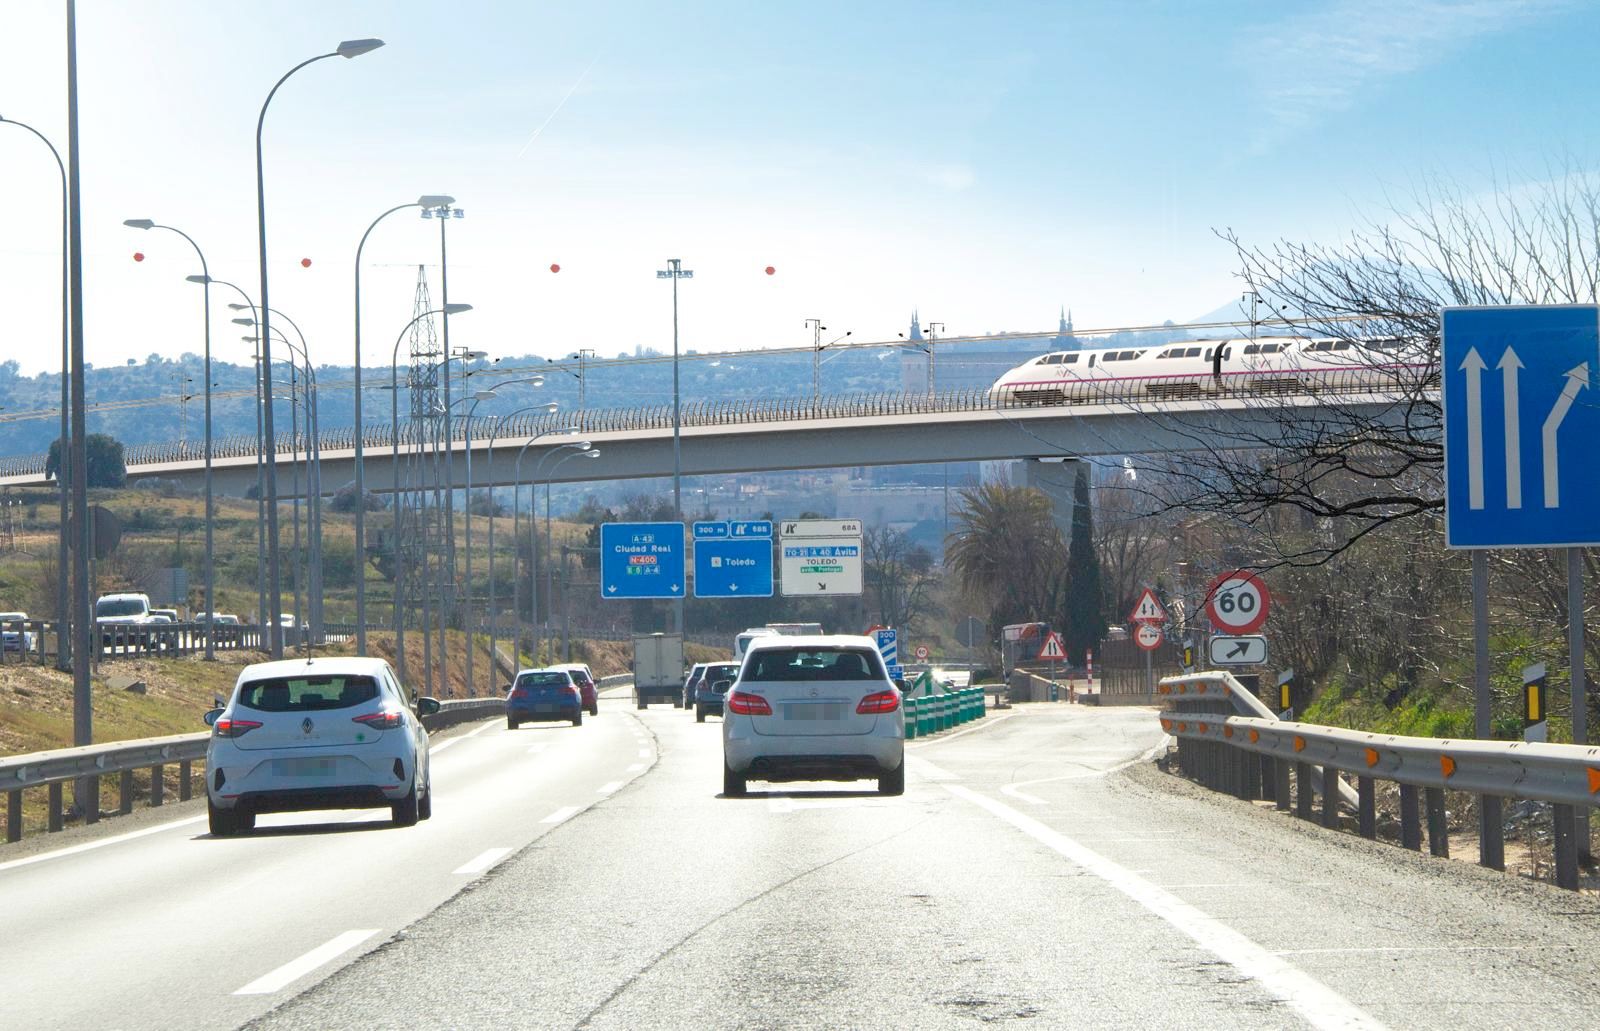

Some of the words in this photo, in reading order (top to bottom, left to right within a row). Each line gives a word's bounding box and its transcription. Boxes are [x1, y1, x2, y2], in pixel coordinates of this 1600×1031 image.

[615, 545, 647, 553] Ciudad
[651, 545, 672, 553] Real
[725, 558, 756, 566] Toledo
[1219, 592, 1255, 613] 60
